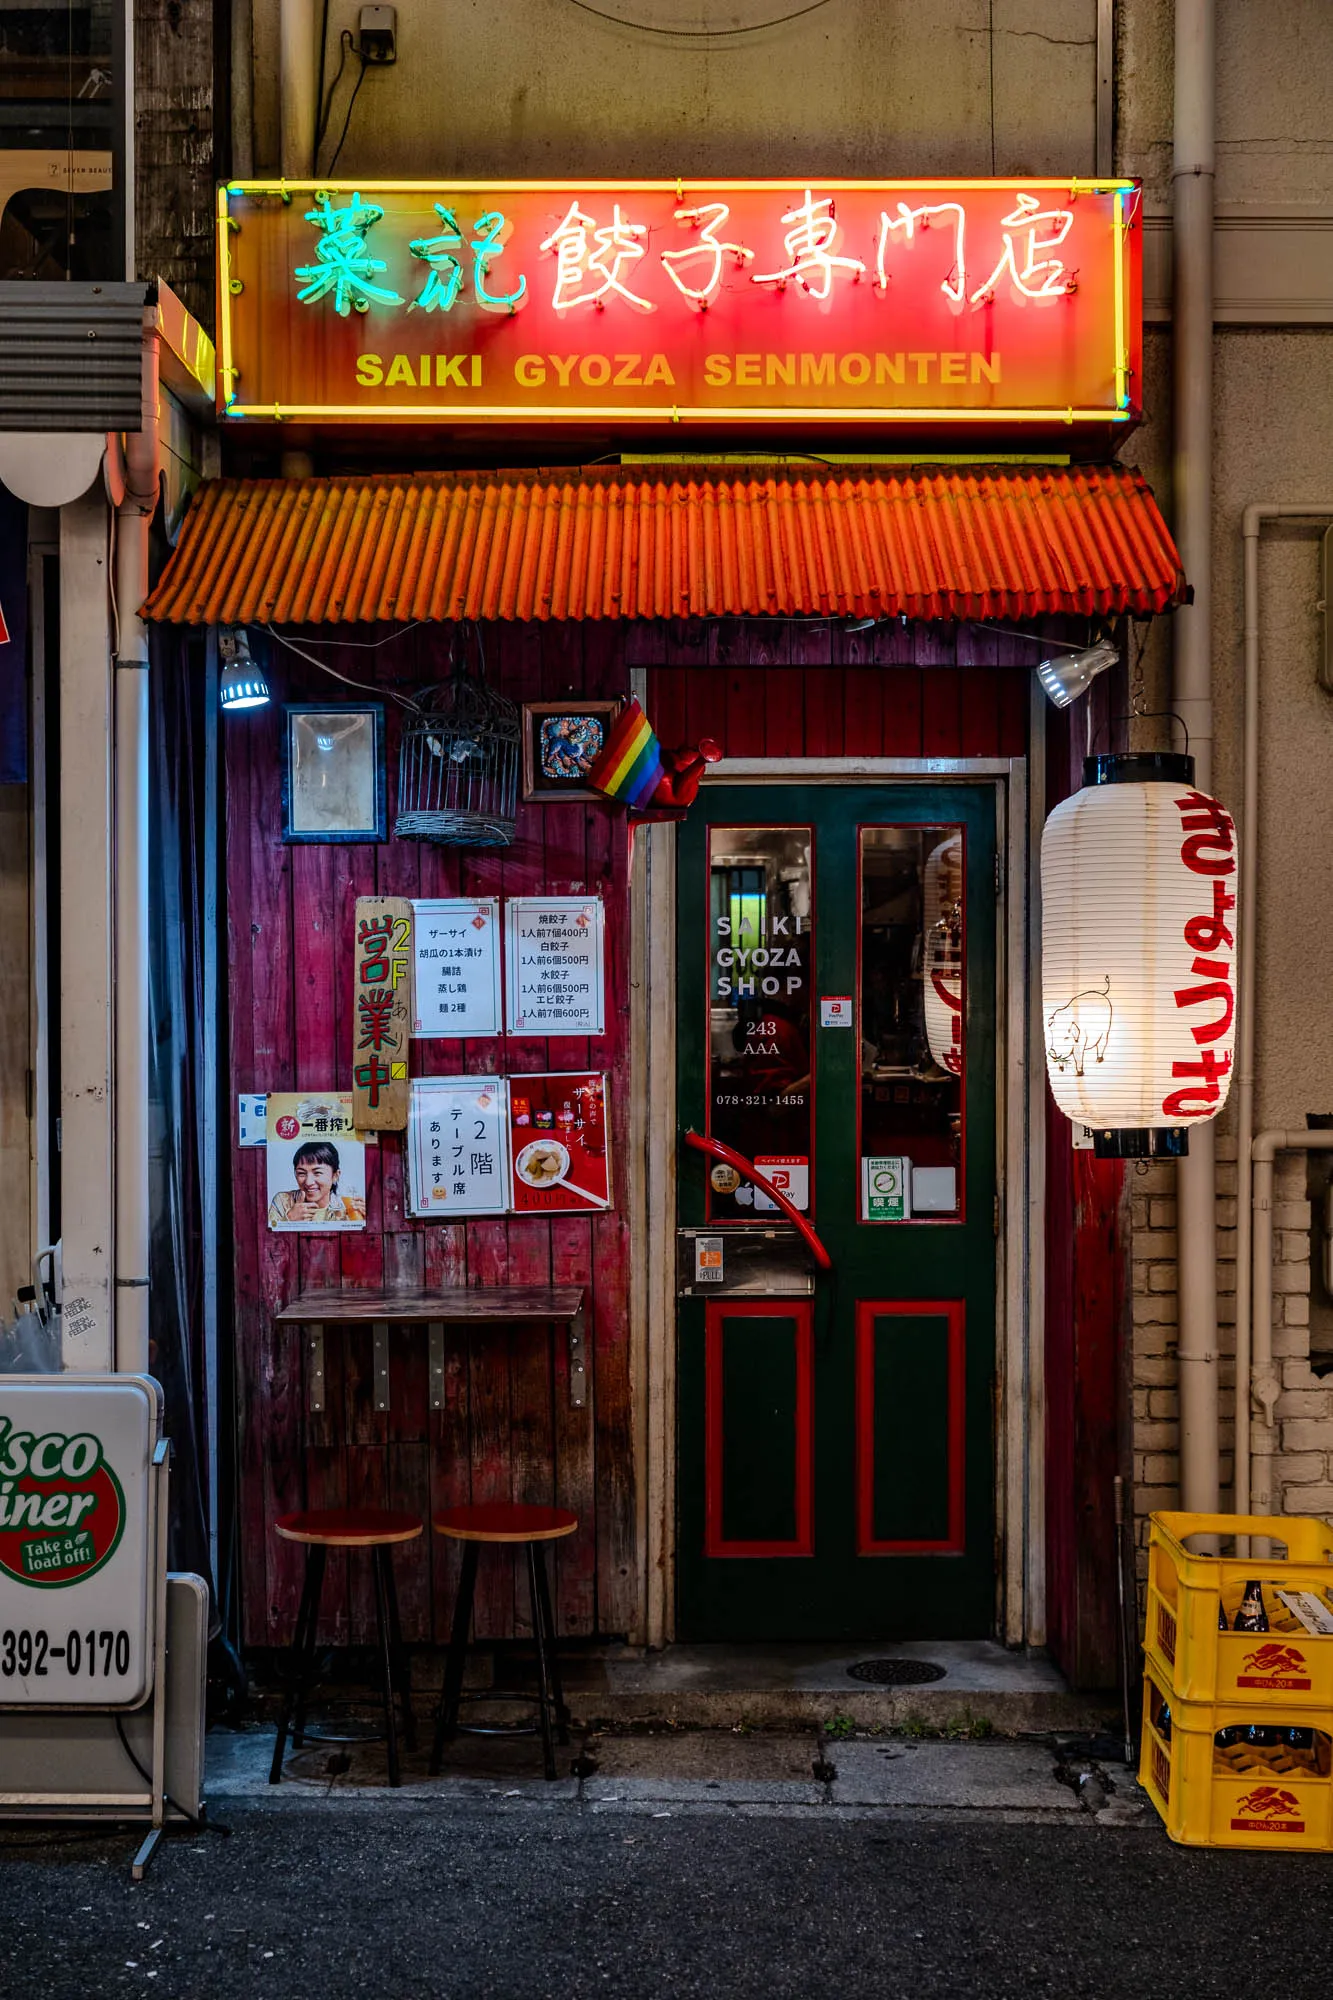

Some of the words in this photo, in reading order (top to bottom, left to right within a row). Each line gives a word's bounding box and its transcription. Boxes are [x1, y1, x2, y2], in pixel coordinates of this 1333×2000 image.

[355, 354, 482, 387] SAIKI
[514, 354, 675, 387] GYOZA
[704, 352, 1001, 386] SENMONTEN
[538, 915, 568, 924] 焼餃子
[717, 916, 801, 935] SAIKI
[428, 929, 467, 938] ザーサイ
[521, 928, 589, 938] 1人前7個400円
[419, 948, 483, 959] 胡瓜の1本漬け
[540, 942, 569, 951] 白餃子
[521, 955, 589, 965] 1人前6個500円
[716, 948, 801, 967] GYOZA
[540, 970, 570, 980] 水餃子
[438, 983, 467, 994] 蒸し鶏
[521, 984, 589, 993] 1人前6個500円
[717, 976, 802, 996] SHOP
[536, 995, 575, 1005] エビ餃子
[355, 914, 397, 1109] 営業中
[522, 1008, 590, 1018] 1人前7個600円
[746, 1021, 777, 1036] 243
[743, 1042, 780, 1055] AAA
[573, 1087, 586, 1147] ザーサイ
[430, 1121, 443, 1184] あります
[450, 1109, 466, 1195] テーブル席
[470, 1120, 493, 1175] 2階
[0, 1419, 99, 1478] sco
[25, 1539, 62, 1557] Take
[64, 1539, 73, 1550] a
[28, 1553, 61, 1571] load
[64, 1548, 91, 1564] off!
